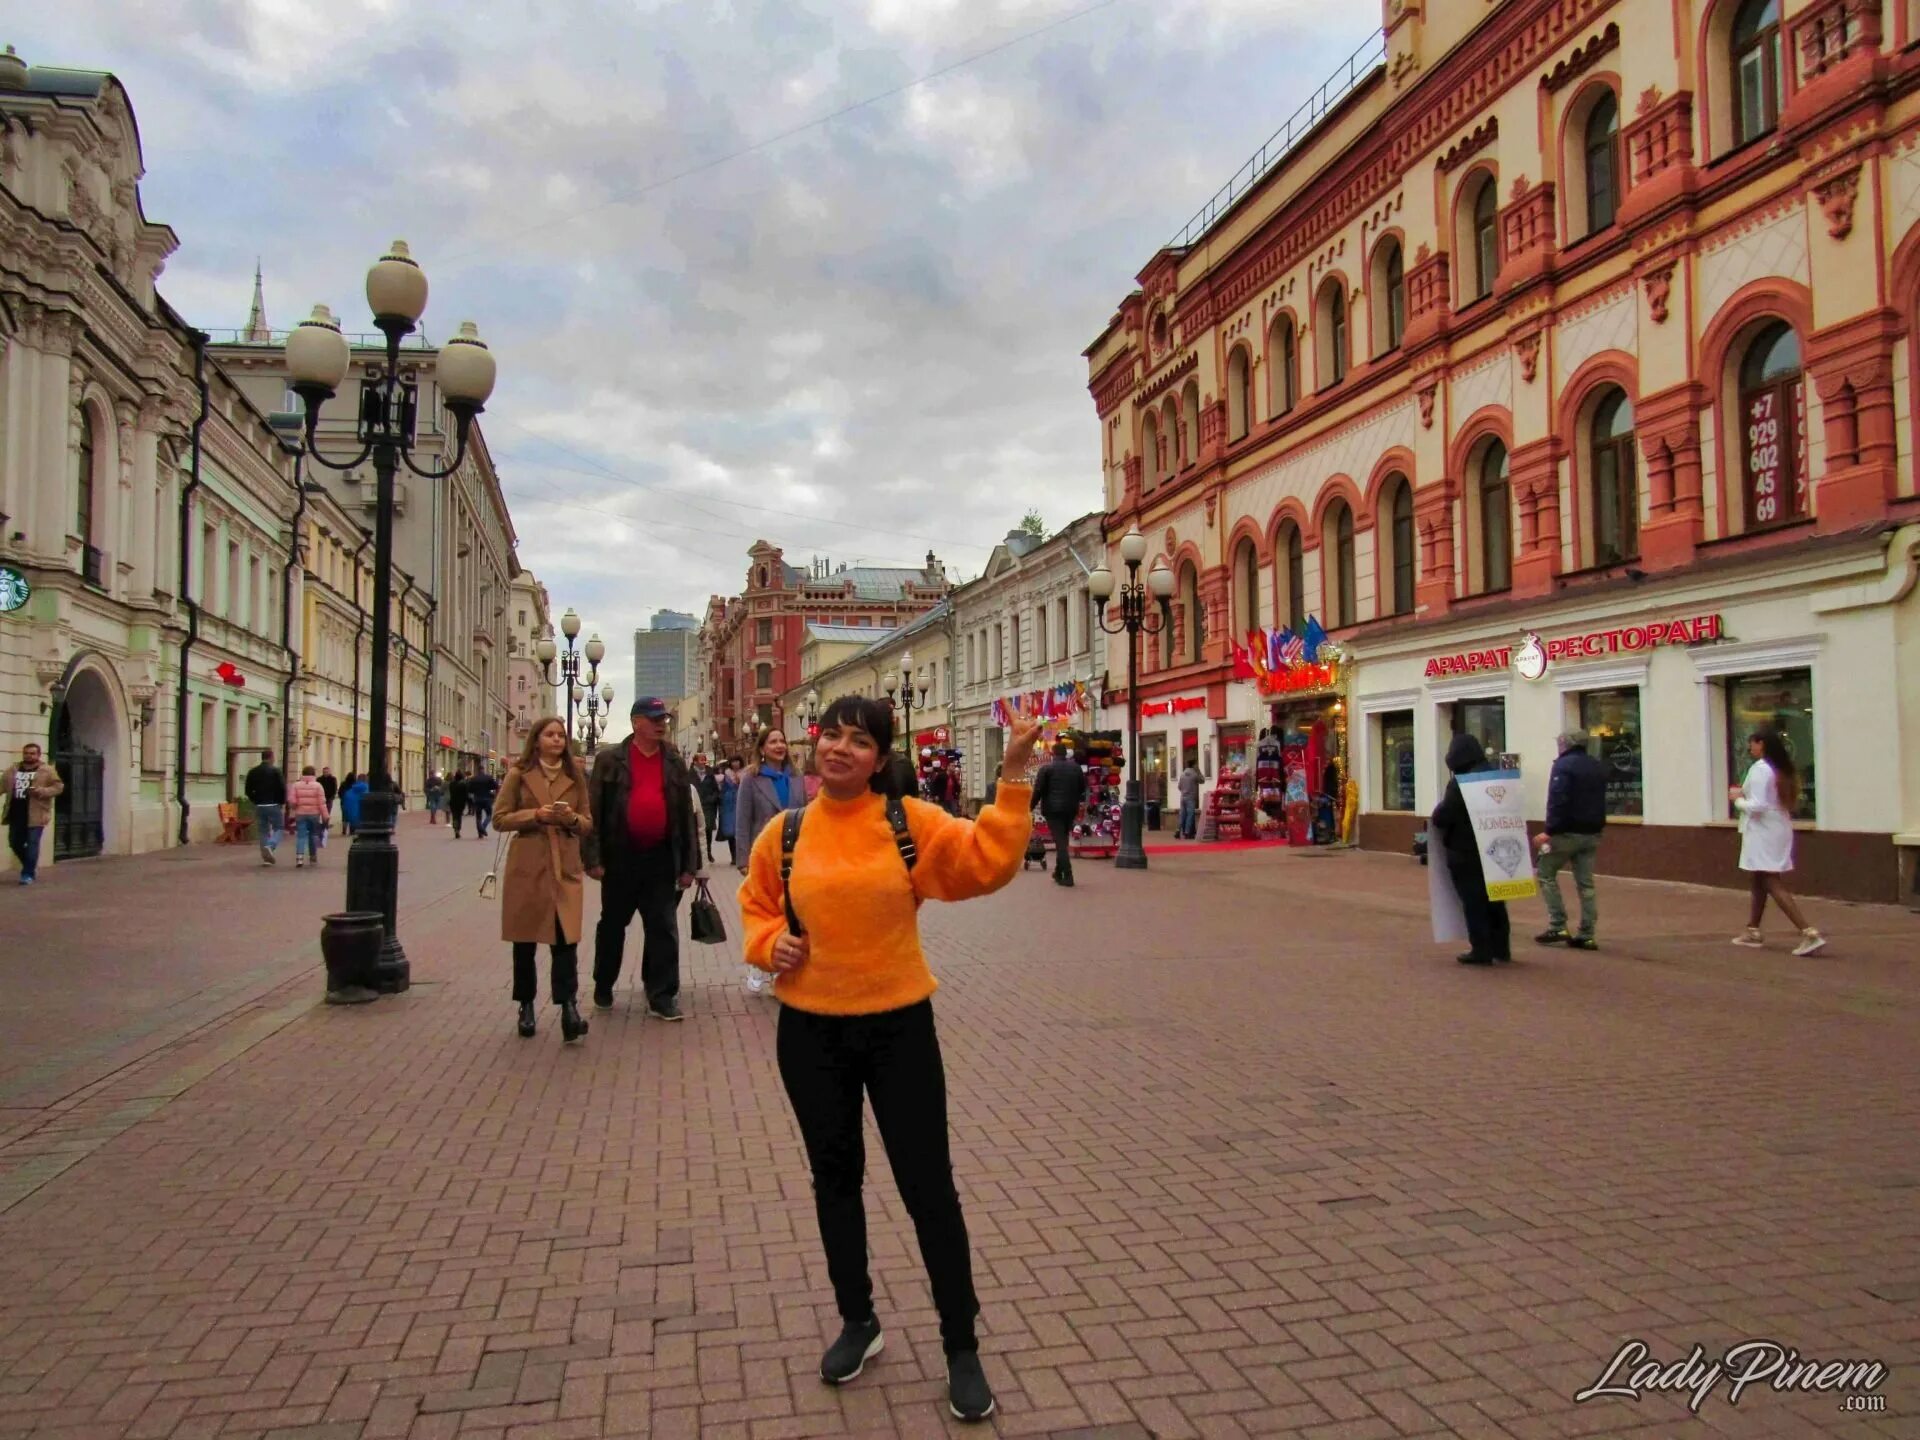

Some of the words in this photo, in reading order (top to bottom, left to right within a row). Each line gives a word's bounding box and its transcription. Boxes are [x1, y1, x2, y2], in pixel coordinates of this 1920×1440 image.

[1751, 394, 1774, 418] +7
[1749, 418, 1777, 448] 929
[1750, 444, 1779, 472] 602
[1755, 470, 1775, 495] 45
[1756, 496, 1776, 521] 69
[1424, 646, 1512, 677] АРАРАТ
[1547, 614, 1720, 661] РЕСТОРАН
